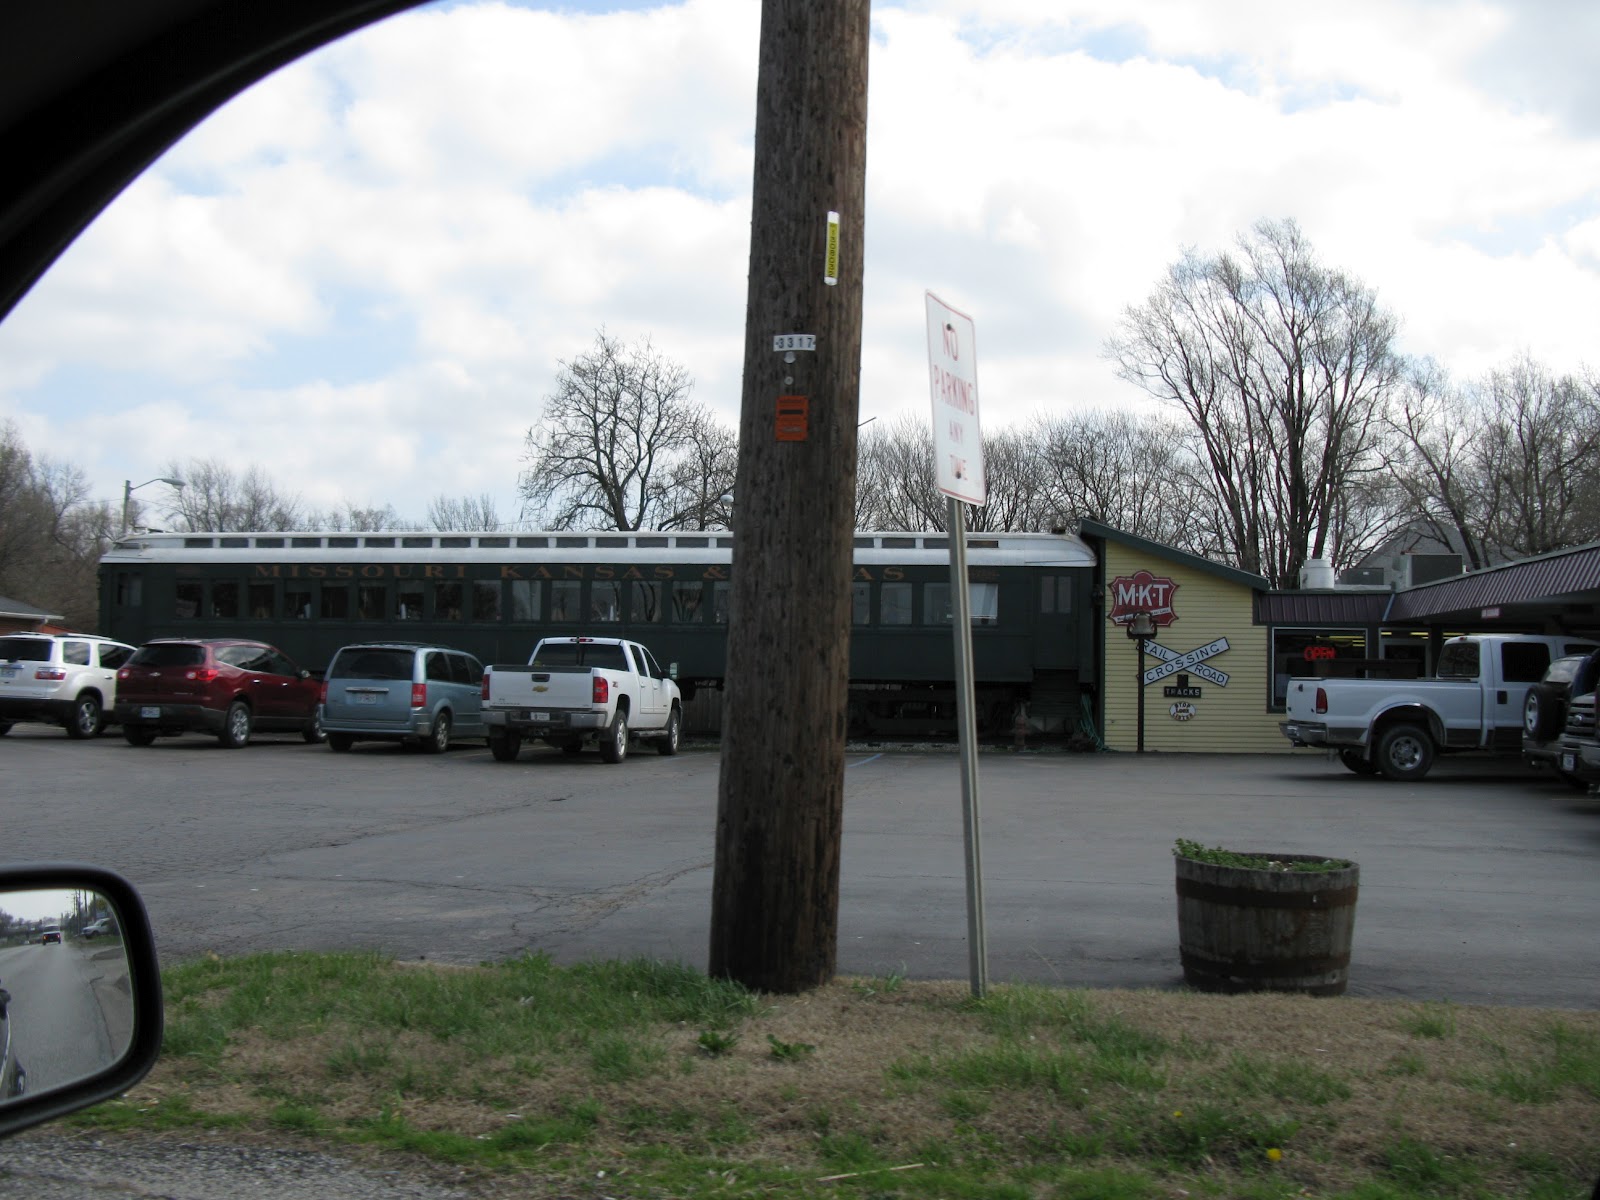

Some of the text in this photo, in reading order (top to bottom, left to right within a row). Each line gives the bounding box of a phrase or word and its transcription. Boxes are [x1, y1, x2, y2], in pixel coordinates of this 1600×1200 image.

[778, 337, 812, 349] 3317
[942, 321, 959, 361] NO
[934, 365, 974, 416] PARKING
[254, 565, 729, 580] MISSOURI KANSAS &
[1144, 641, 1225, 683] RAIL ROAD
[1146, 644, 1220, 681] CROSSING
[1304, 645, 1336, 662] OPEN
[1166, 688, 1200, 696] TRACKS
